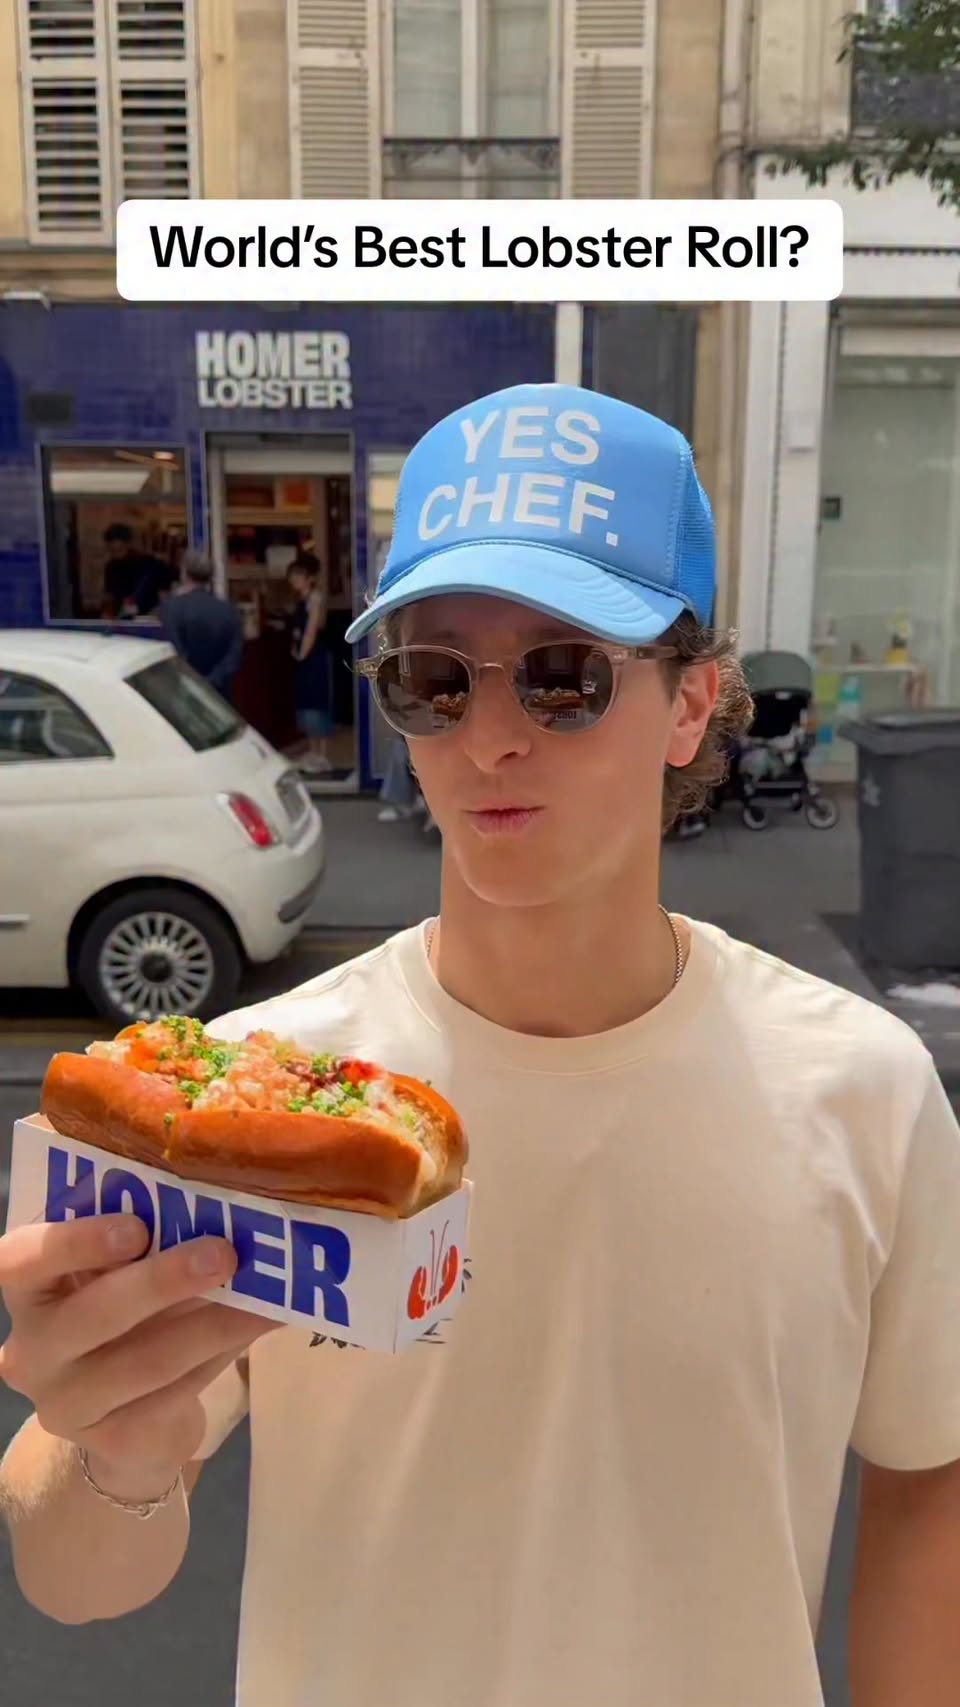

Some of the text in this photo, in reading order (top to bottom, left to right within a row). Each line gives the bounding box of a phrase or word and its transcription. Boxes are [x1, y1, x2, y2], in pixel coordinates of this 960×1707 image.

[195, 331, 351, 379] HOMER
[198, 378, 353, 409] LOBSTER
[460, 405, 602, 466] YES
[418, 473, 618, 548] CHEF.
